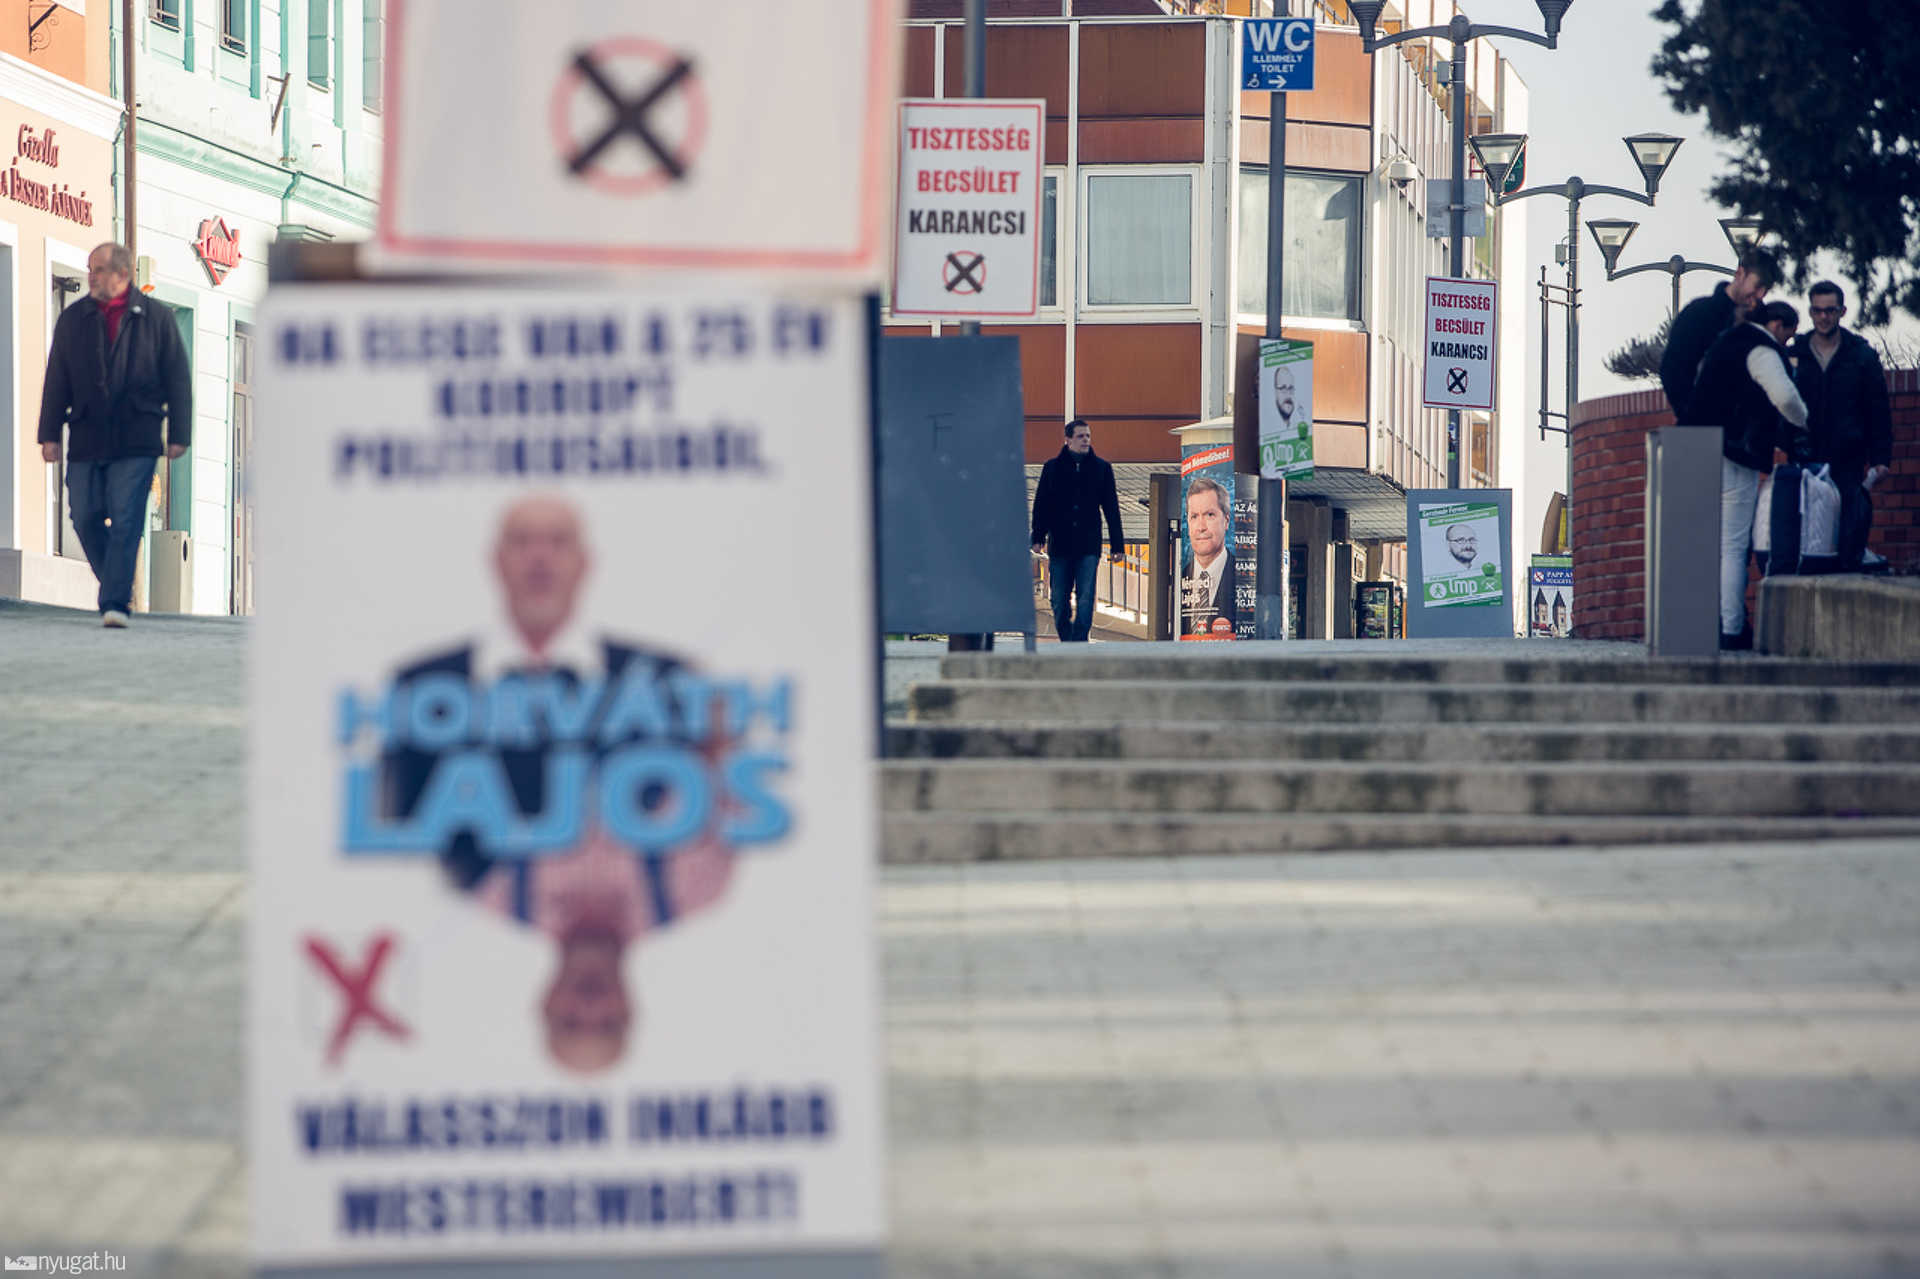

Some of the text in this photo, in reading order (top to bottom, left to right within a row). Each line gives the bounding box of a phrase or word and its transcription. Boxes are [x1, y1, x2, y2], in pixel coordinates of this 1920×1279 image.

[1247, 21, 1311, 52] WC
[1252, 55, 1303, 63] ILLEMHELY
[1261, 64, 1295, 73] TOILET
[907, 123, 1030, 151] TISZTESSÉG
[917, 166, 1021, 193] BECSÜLET
[909, 209, 1026, 235] KARANCSI
[1431, 293, 1490, 311] TISZTESSÉG
[1435, 318, 1485, 335] BECSÜLET
[1431, 341, 1487, 360] KARANCSI
[1448, 578, 1478, 597] lmp
[337, 656, 791, 750] HORVÁTH
[342, 746, 793, 854] LAJOS
